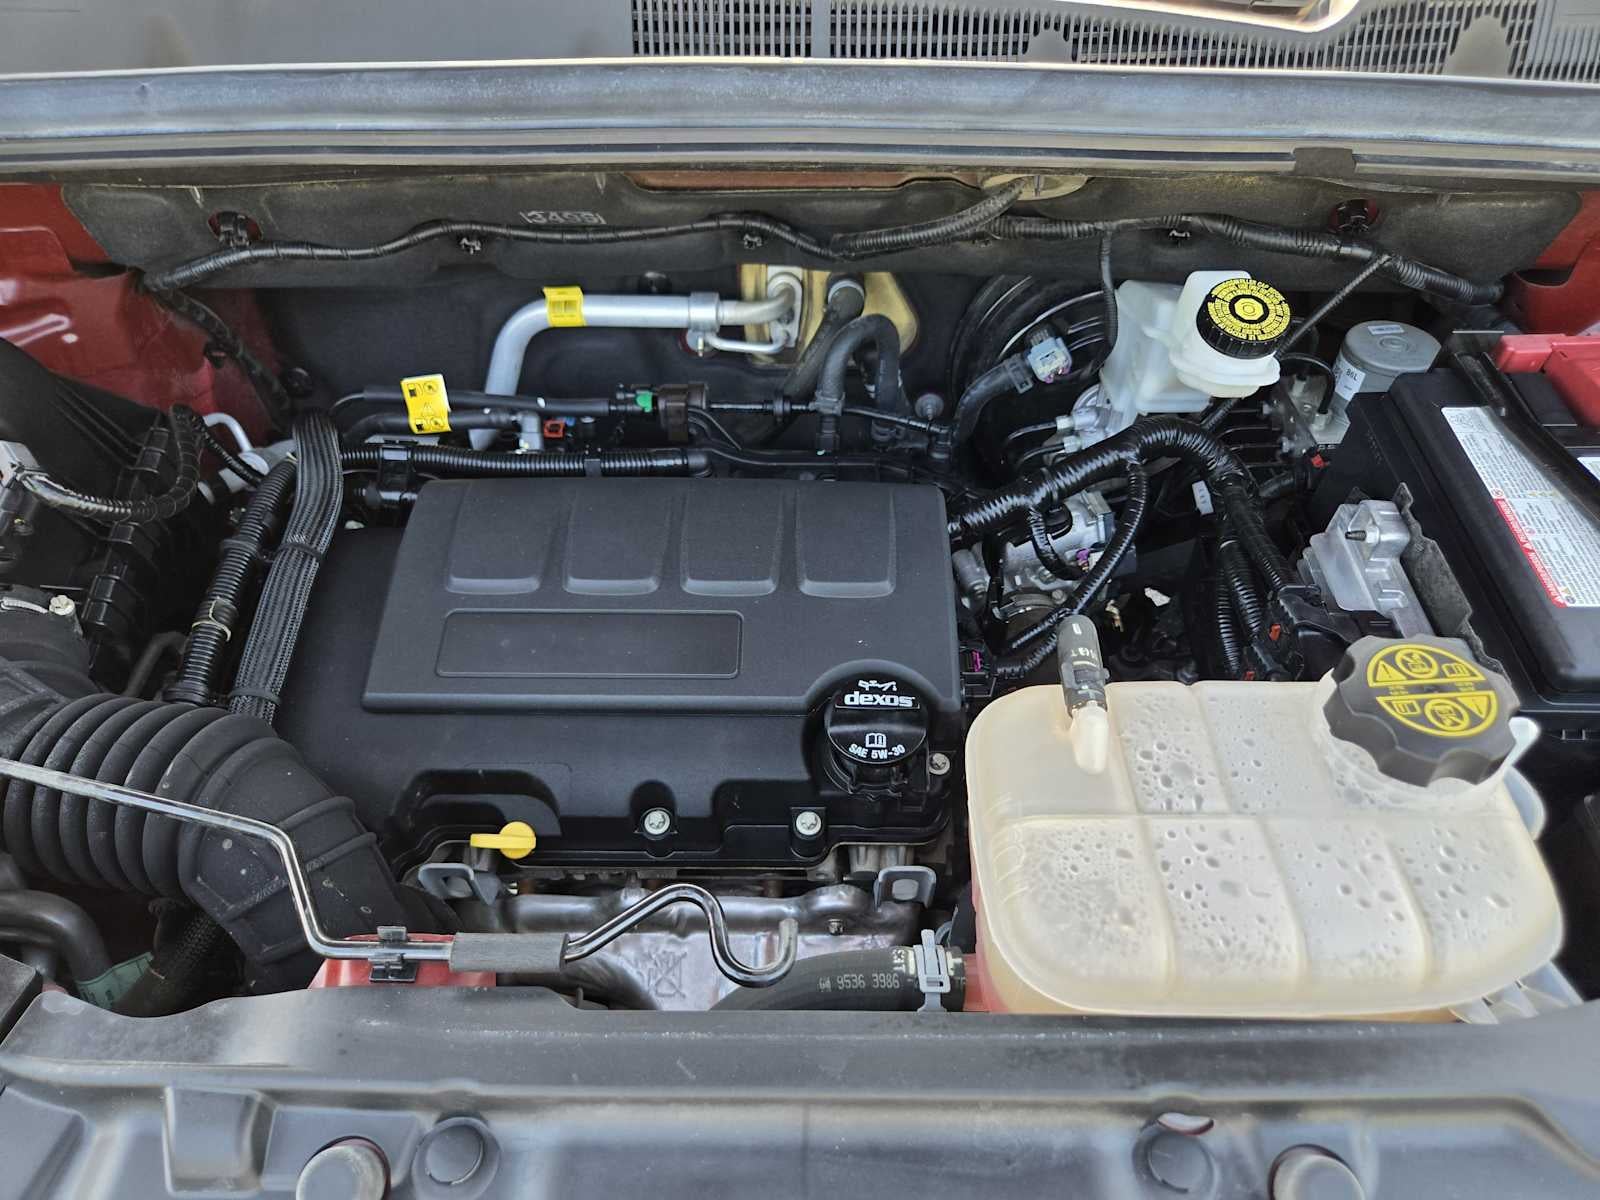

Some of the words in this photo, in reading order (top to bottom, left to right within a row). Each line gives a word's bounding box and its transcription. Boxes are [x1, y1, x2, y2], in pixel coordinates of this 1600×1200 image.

[844, 691, 914, 706] dexos
[848, 743, 869, 759] SAE
[871, 744, 906, 760] 5W-30
[836, 973, 866, 990] 9536
[872, 972, 900, 989] 3986
